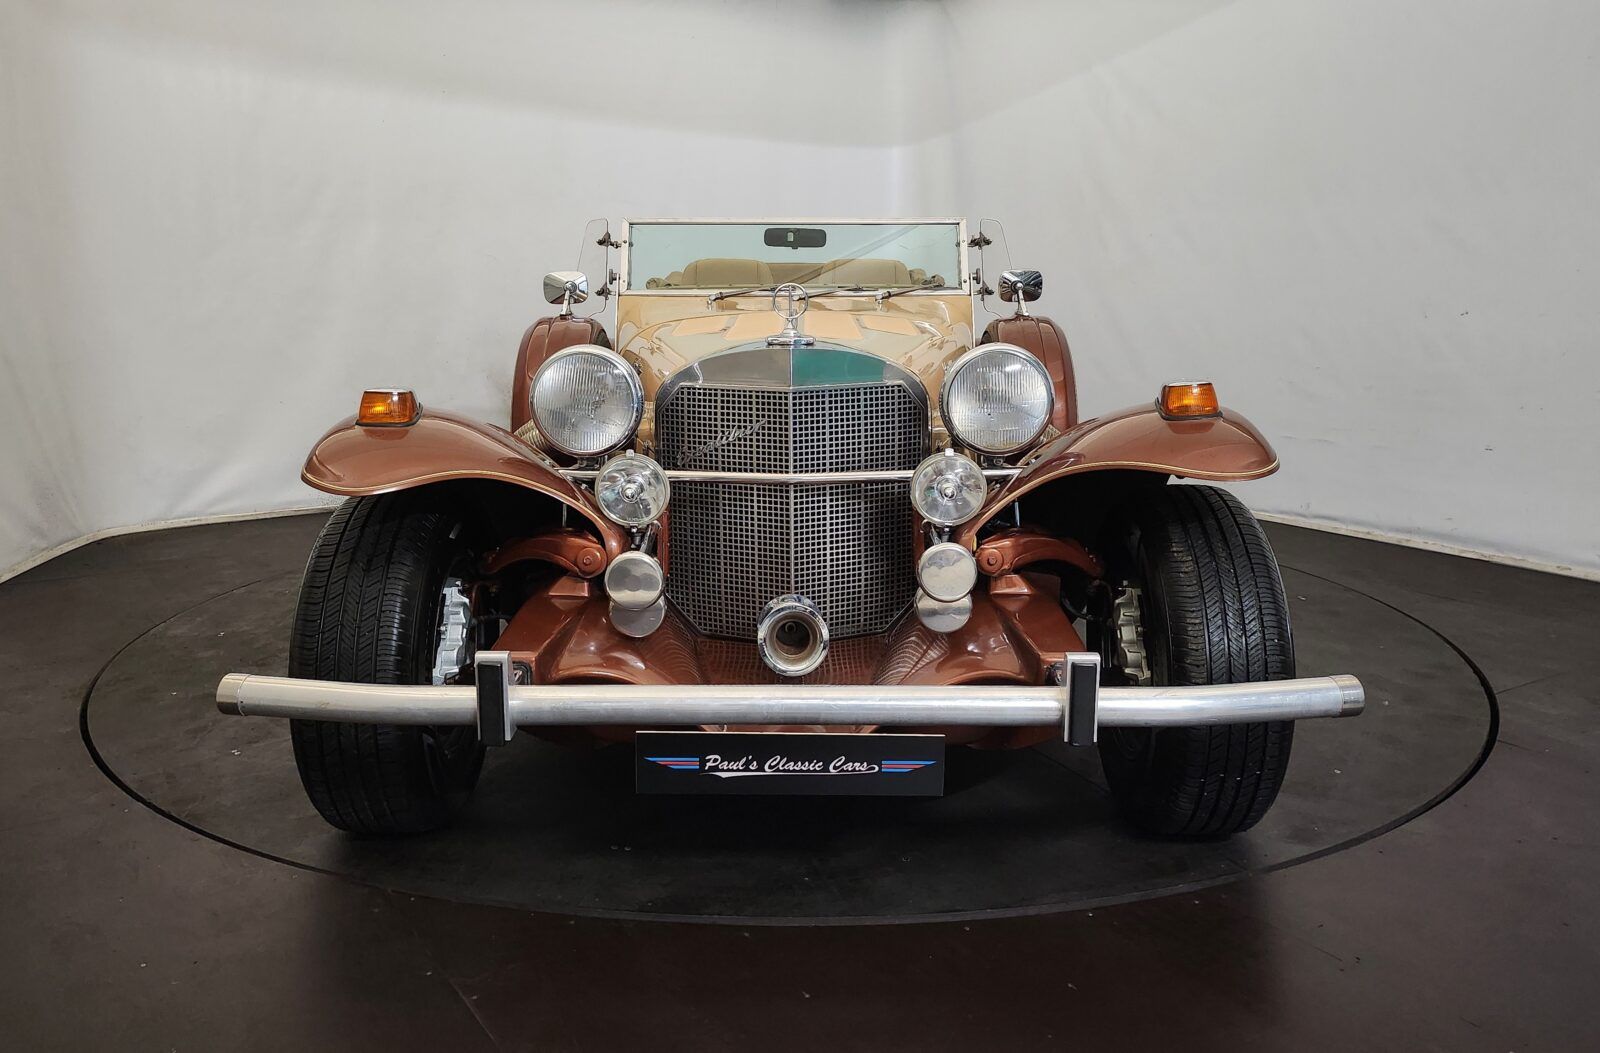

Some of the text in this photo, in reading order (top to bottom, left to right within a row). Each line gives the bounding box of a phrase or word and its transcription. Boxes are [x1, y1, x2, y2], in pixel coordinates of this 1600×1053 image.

[704, 754, 874, 773] Paul's Classic Cars
